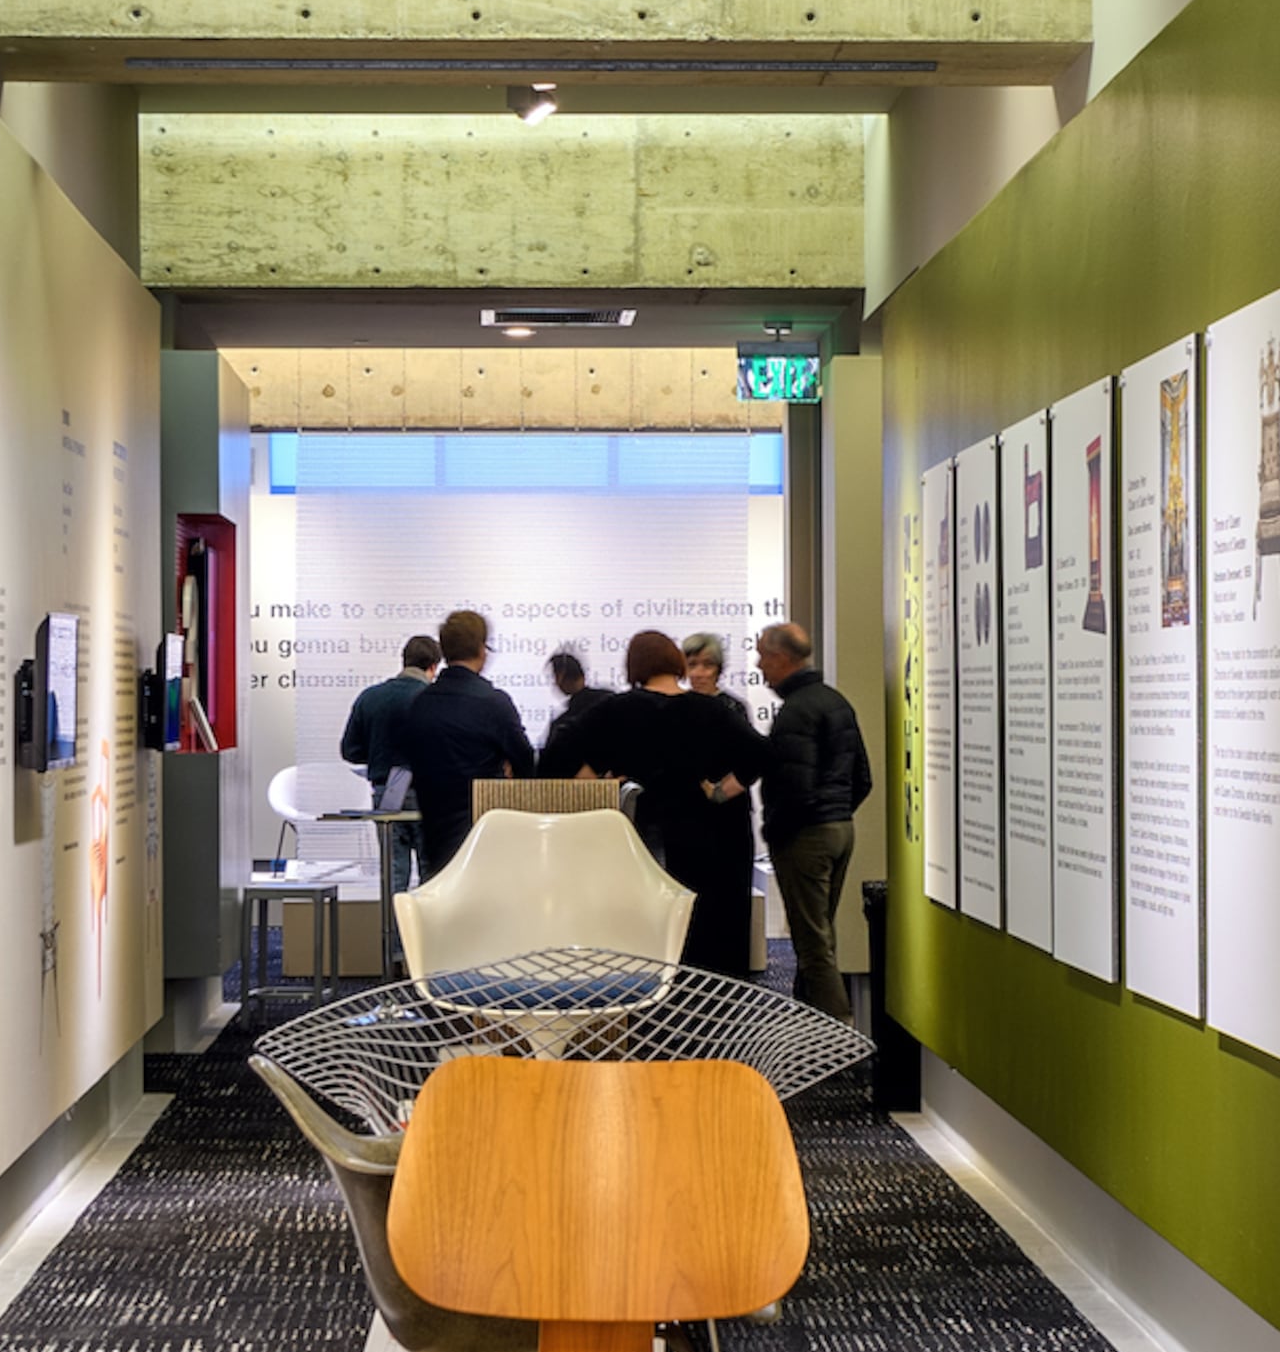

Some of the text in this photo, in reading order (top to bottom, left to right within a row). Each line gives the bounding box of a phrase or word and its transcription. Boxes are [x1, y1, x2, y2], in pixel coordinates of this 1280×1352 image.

[752, 355, 806, 398] EXIT
[271, 600, 331, 618] make
[341, 602, 365, 618] to
[374, 602, 445, 618] create
[502, 601, 590, 622] aspects
[601, 599, 623, 618] of
[633, 598, 753, 617] civilization
[279, 637, 350, 658] gonna
